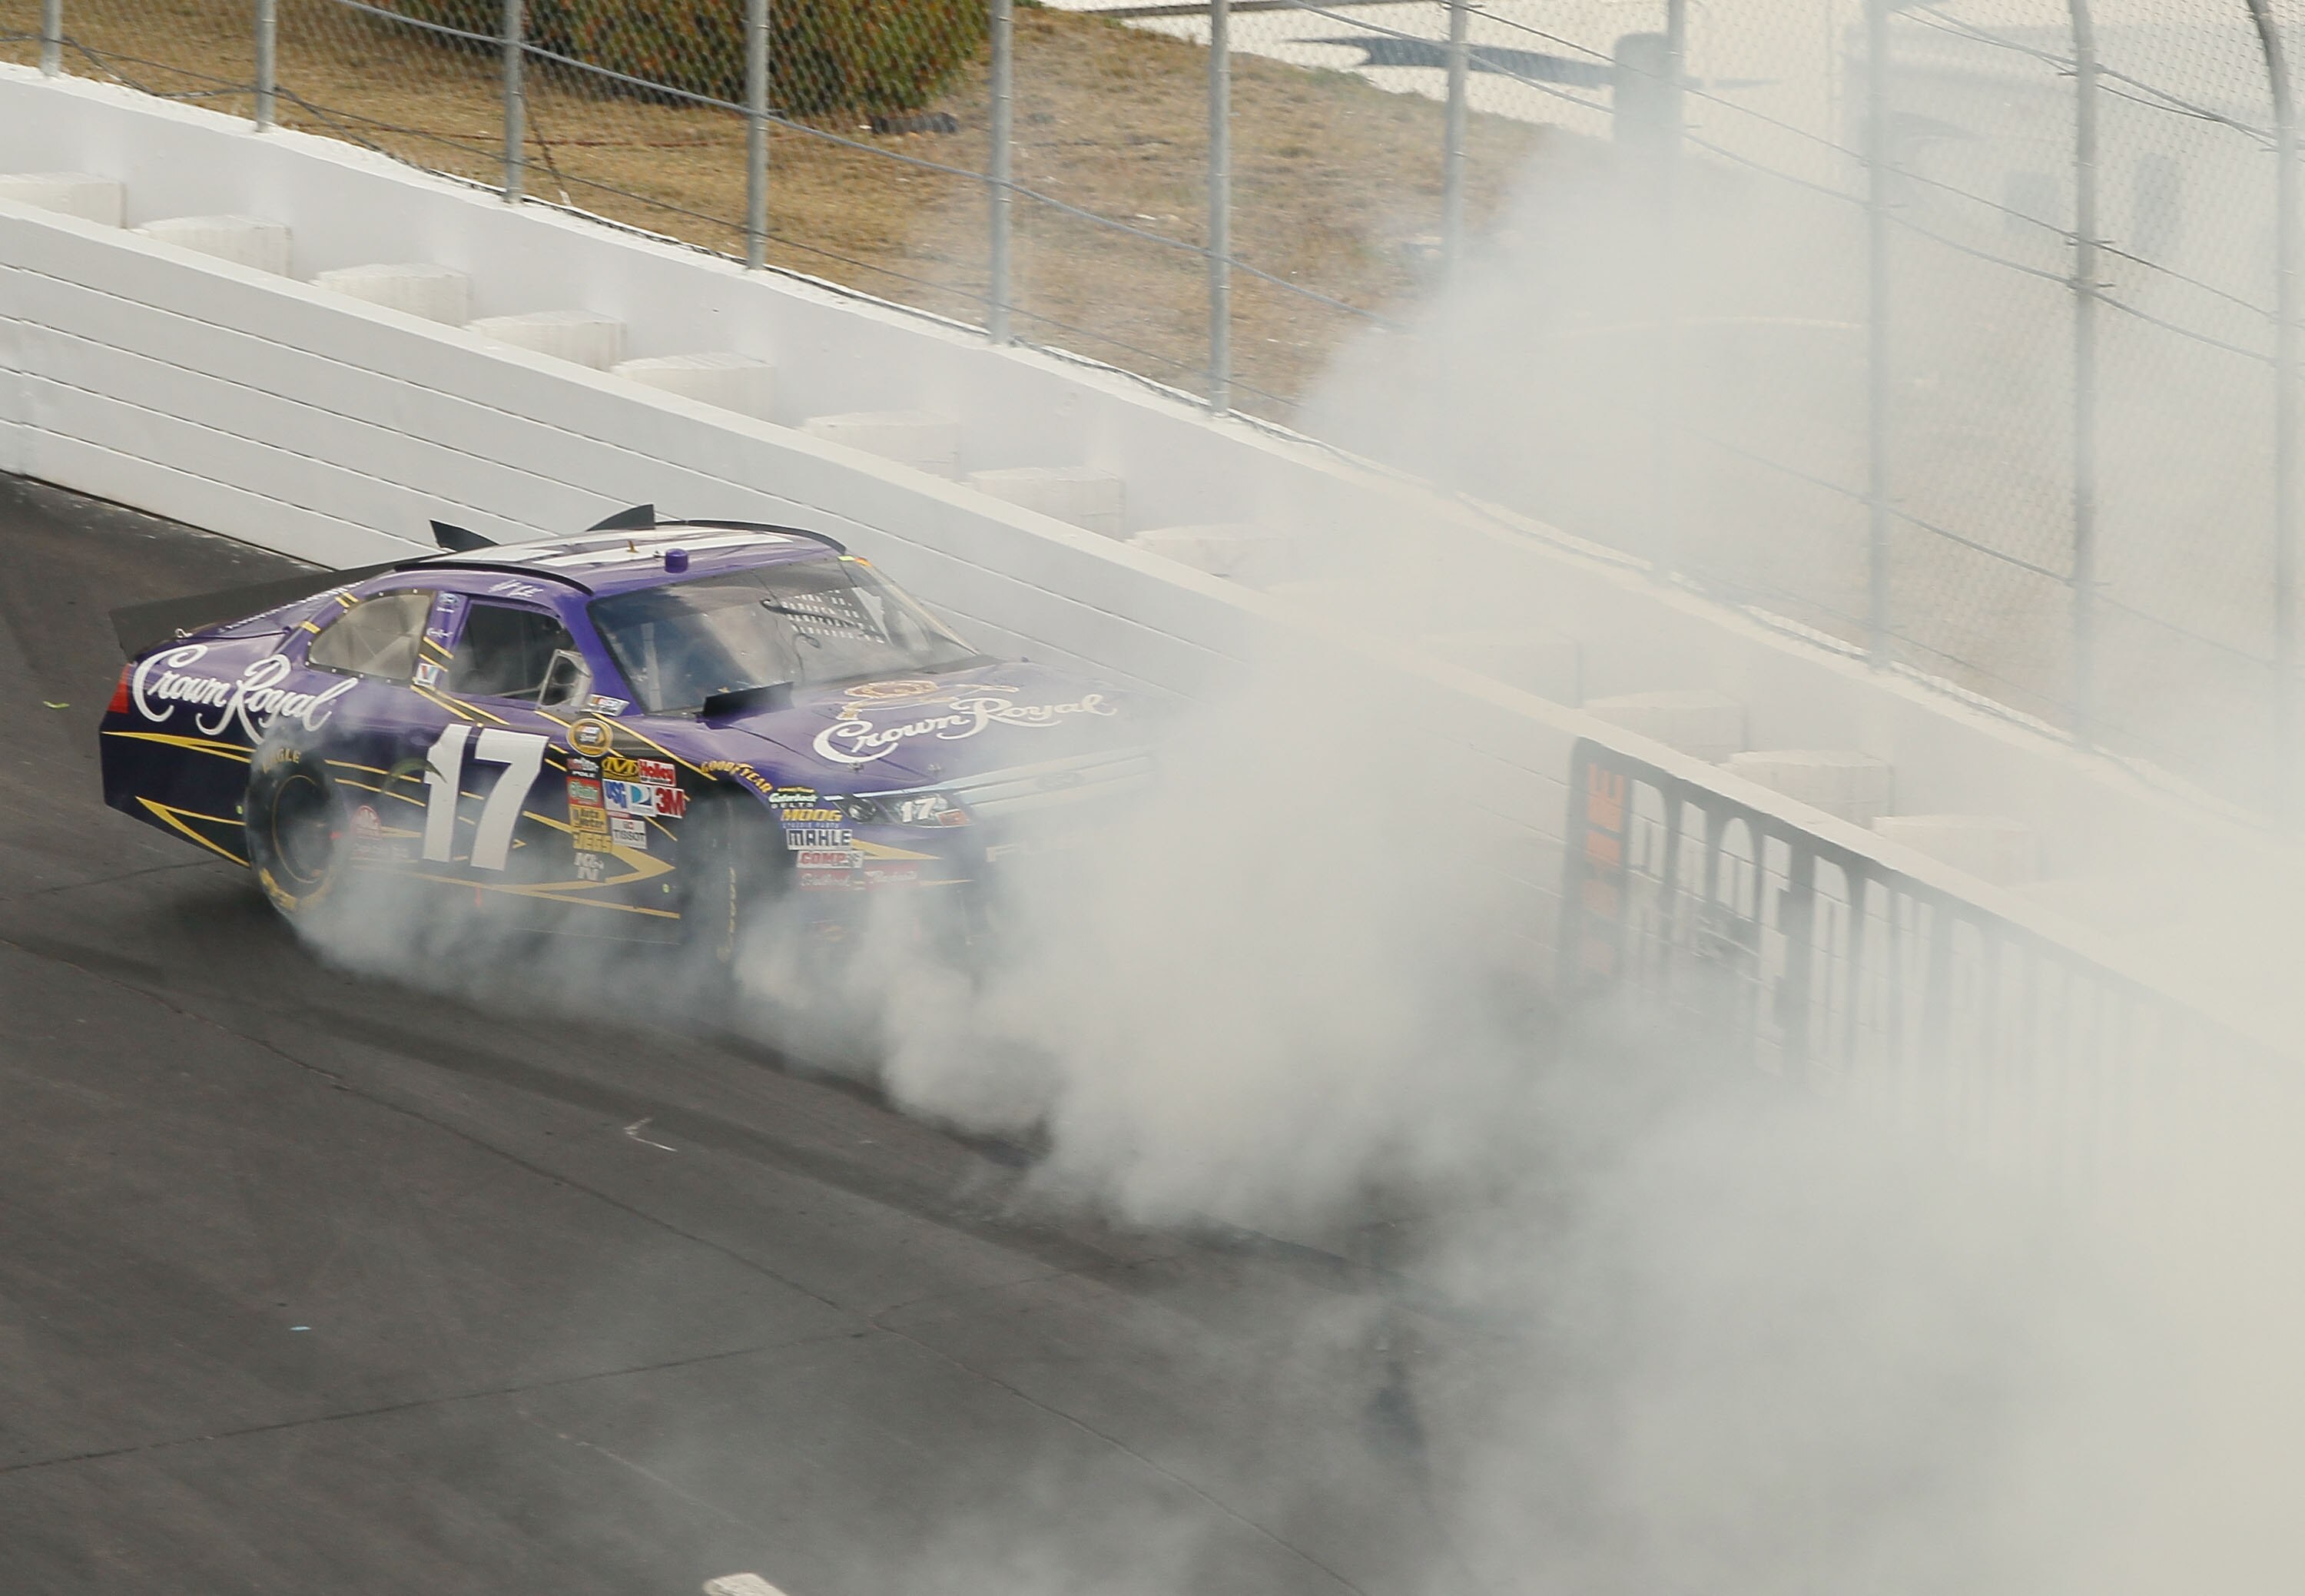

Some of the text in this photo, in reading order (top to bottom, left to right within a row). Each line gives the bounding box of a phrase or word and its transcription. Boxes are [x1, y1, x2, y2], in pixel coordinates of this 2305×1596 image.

[132, 644, 359, 745] Crown Royal
[813, 693, 1118, 765] Crown Royal
[701, 760, 774, 793] GOODYEAR
[423, 723, 549, 871] 17
[655, 787, 685, 817] 3M
[900, 797, 937, 824] 17
[781, 809, 843, 822] MOOG
[572, 831, 612, 853] JEGS
[613, 829, 646, 842] TISSOT
[788, 830, 851, 848] MAHLE
[799, 851, 846, 866] COMP
[1806, 854, 1936, 1118] DAY
